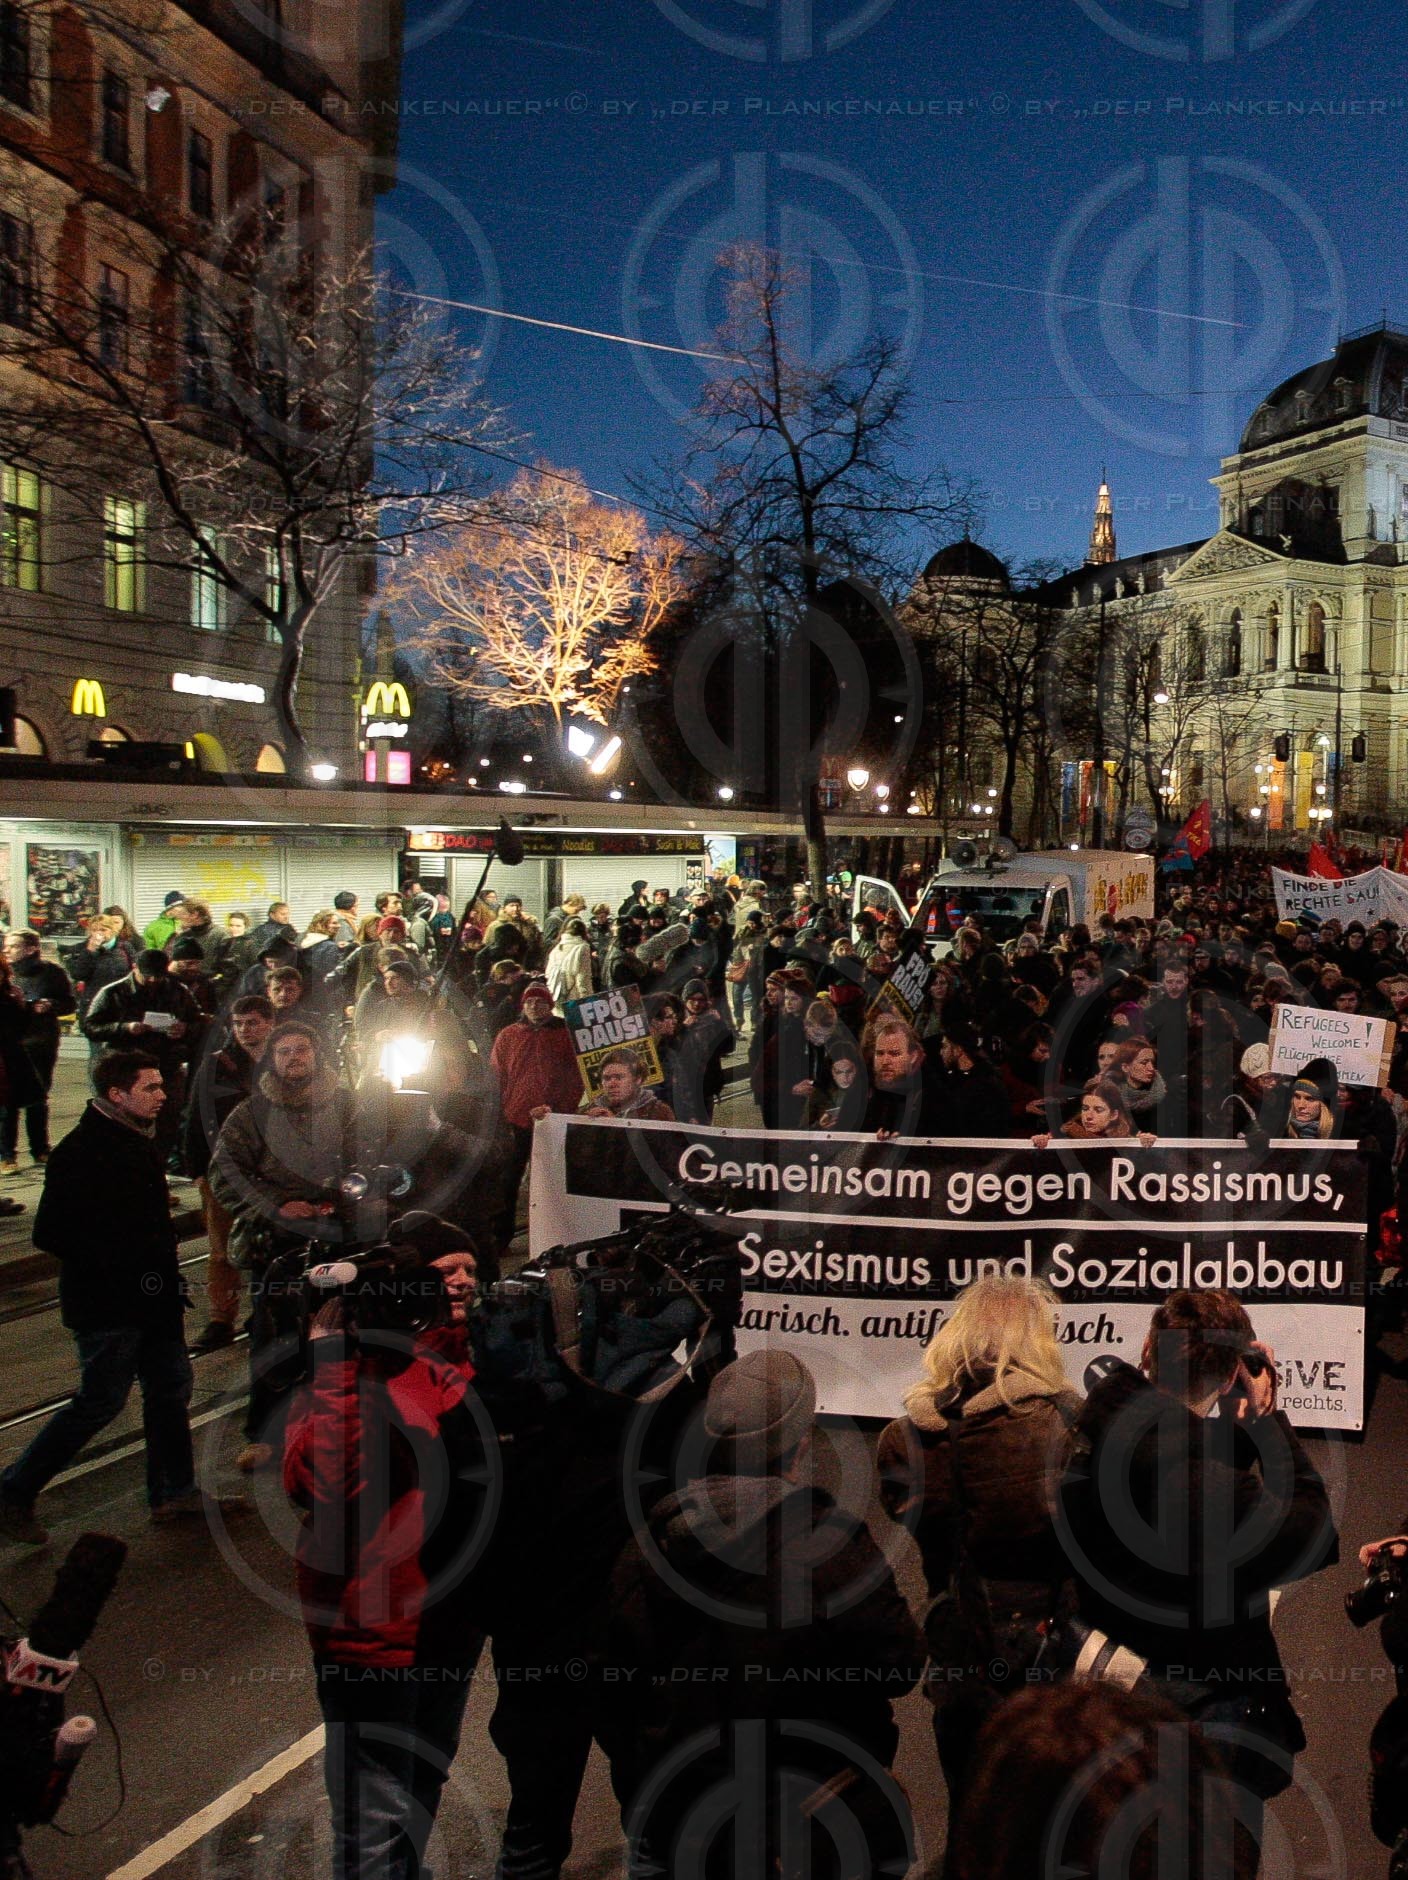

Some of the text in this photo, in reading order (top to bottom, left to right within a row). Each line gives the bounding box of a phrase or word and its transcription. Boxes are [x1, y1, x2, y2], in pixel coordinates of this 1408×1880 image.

[1283, 880, 1328, 893] FINDE
[1333, 879, 1357, 890] DIE
[1286, 895, 1341, 911] RECHTE
[578, 990, 628, 1027] FPÖ
[1282, 1008, 1350, 1035] REFUGEES
[575, 1014, 646, 1052] RAUS!
[678, 1144, 1345, 1216] Gemeinsam gegen Rassismus,
[738, 1232, 1343, 1289] Sexismus und Sozialabbau
[1281, 1394, 1347, 1413] rechts.
